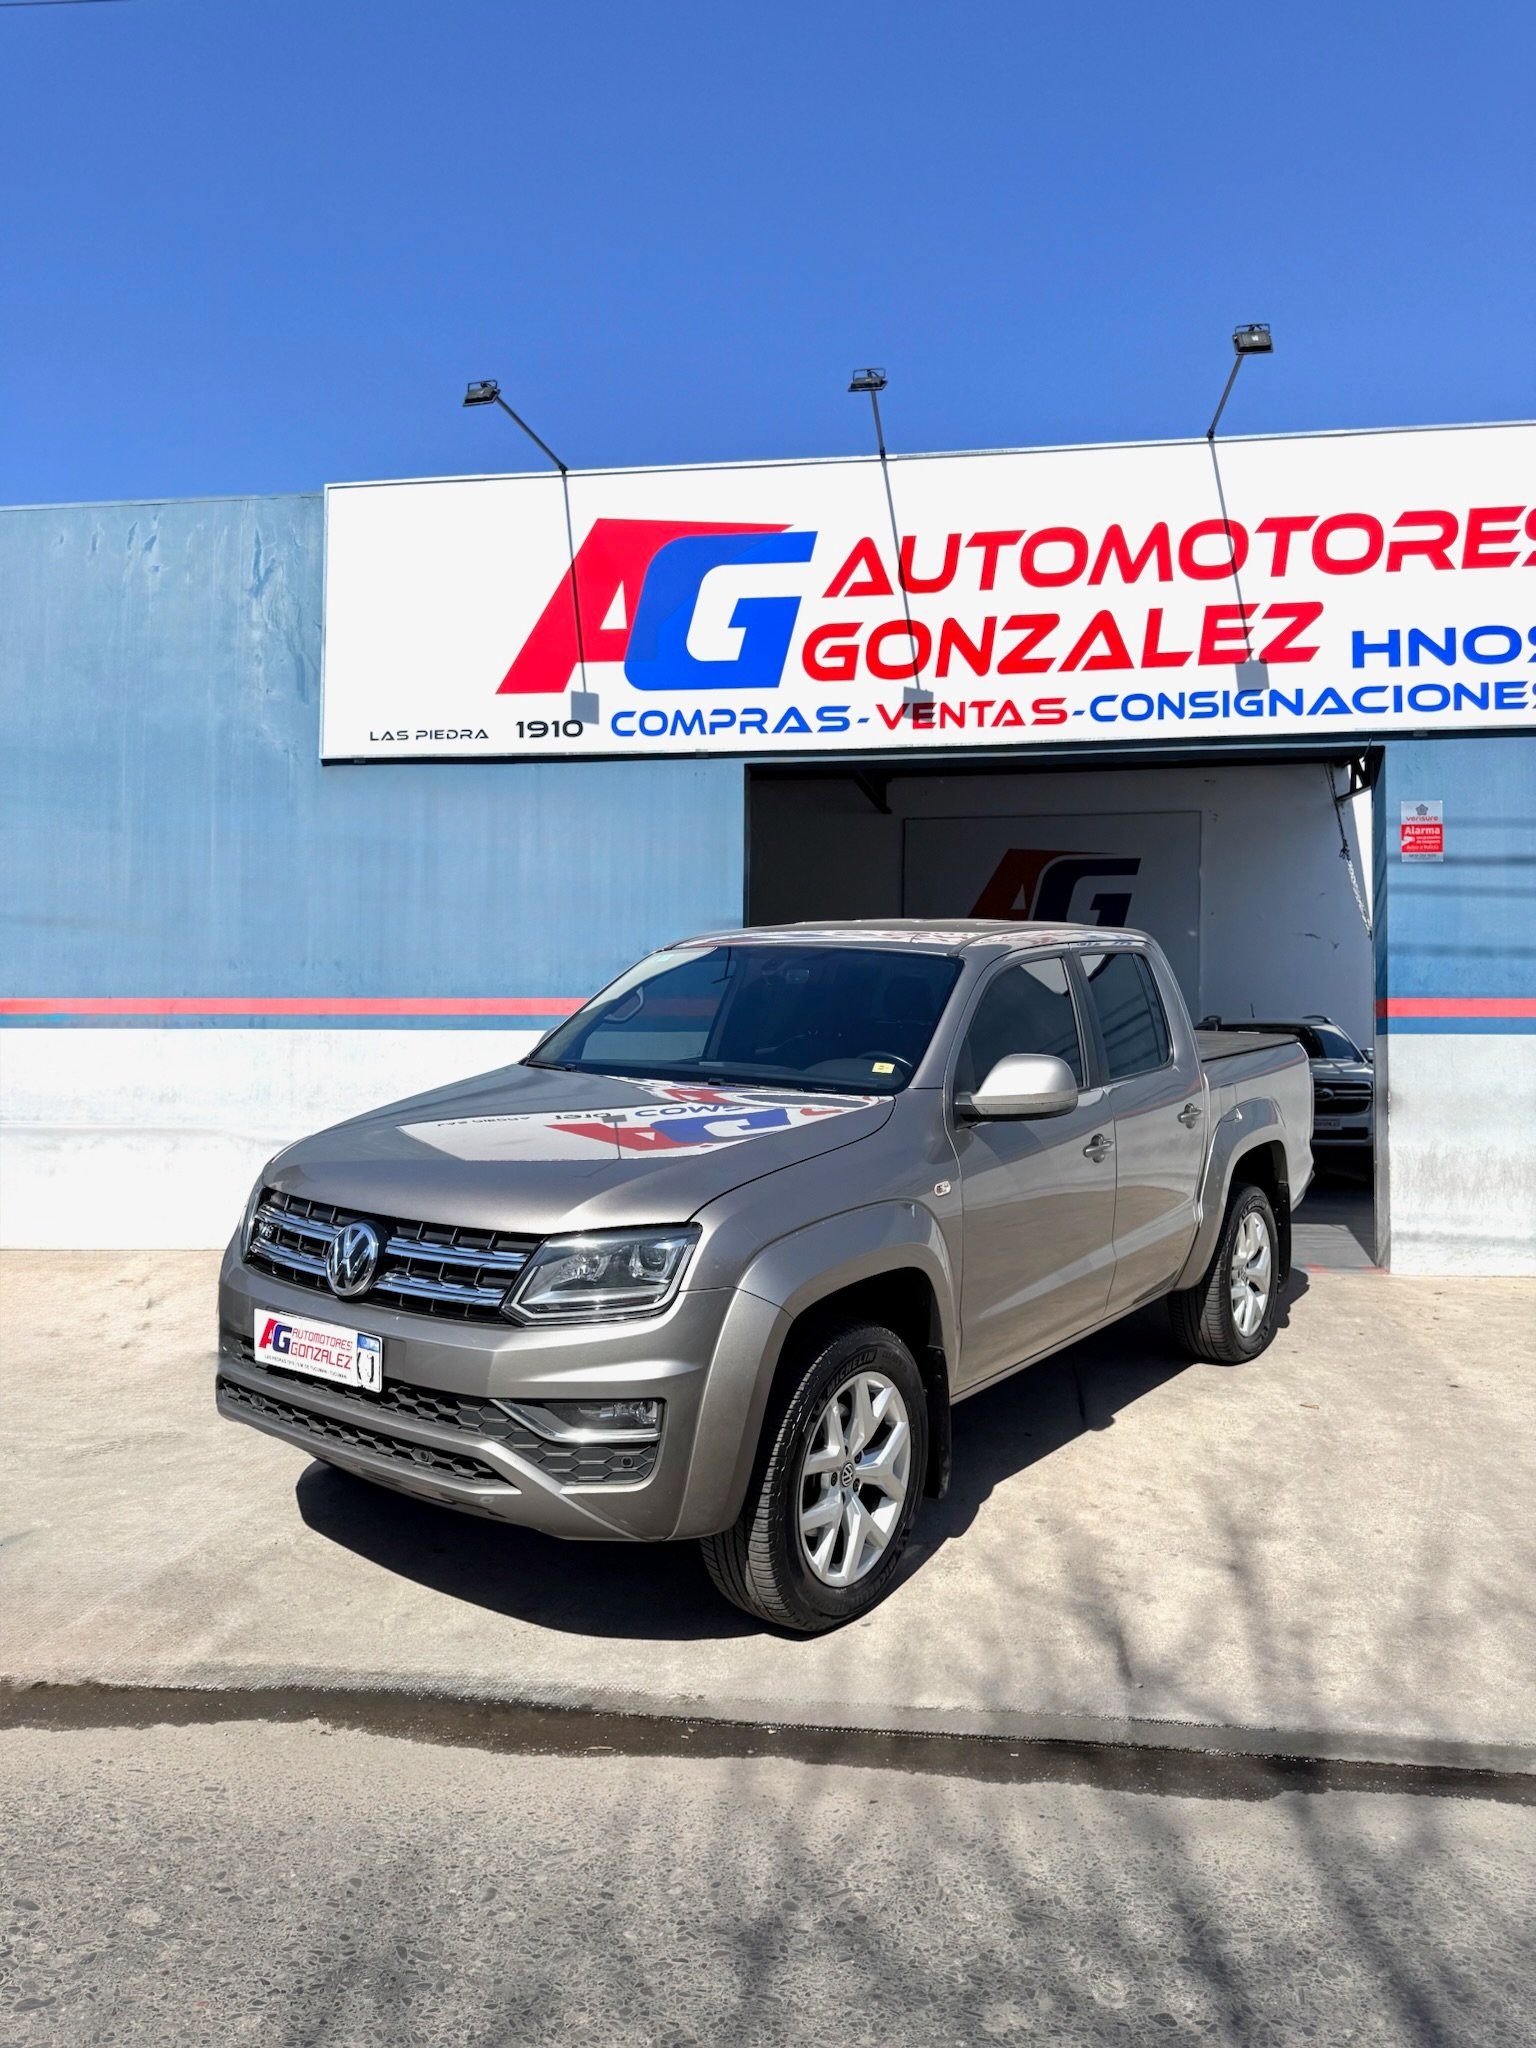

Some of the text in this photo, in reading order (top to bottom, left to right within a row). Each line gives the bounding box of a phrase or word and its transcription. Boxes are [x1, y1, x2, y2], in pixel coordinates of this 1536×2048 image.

[823, 505, 1536, 600] AUTOMOTORE
[495, 517, 819, 695] AG
[801, 601, 1536, 682] GONZALEZ HNO
[370, 719, 584, 741] LAS PIEDRA 1910
[1404, 825, 1441, 835] Alarma
[290, 1341, 353, 1370] GONZALEZ
[291, 1327, 353, 1351] AUTOMOTORES
[826, 1350, 878, 1397] MICHELIN
